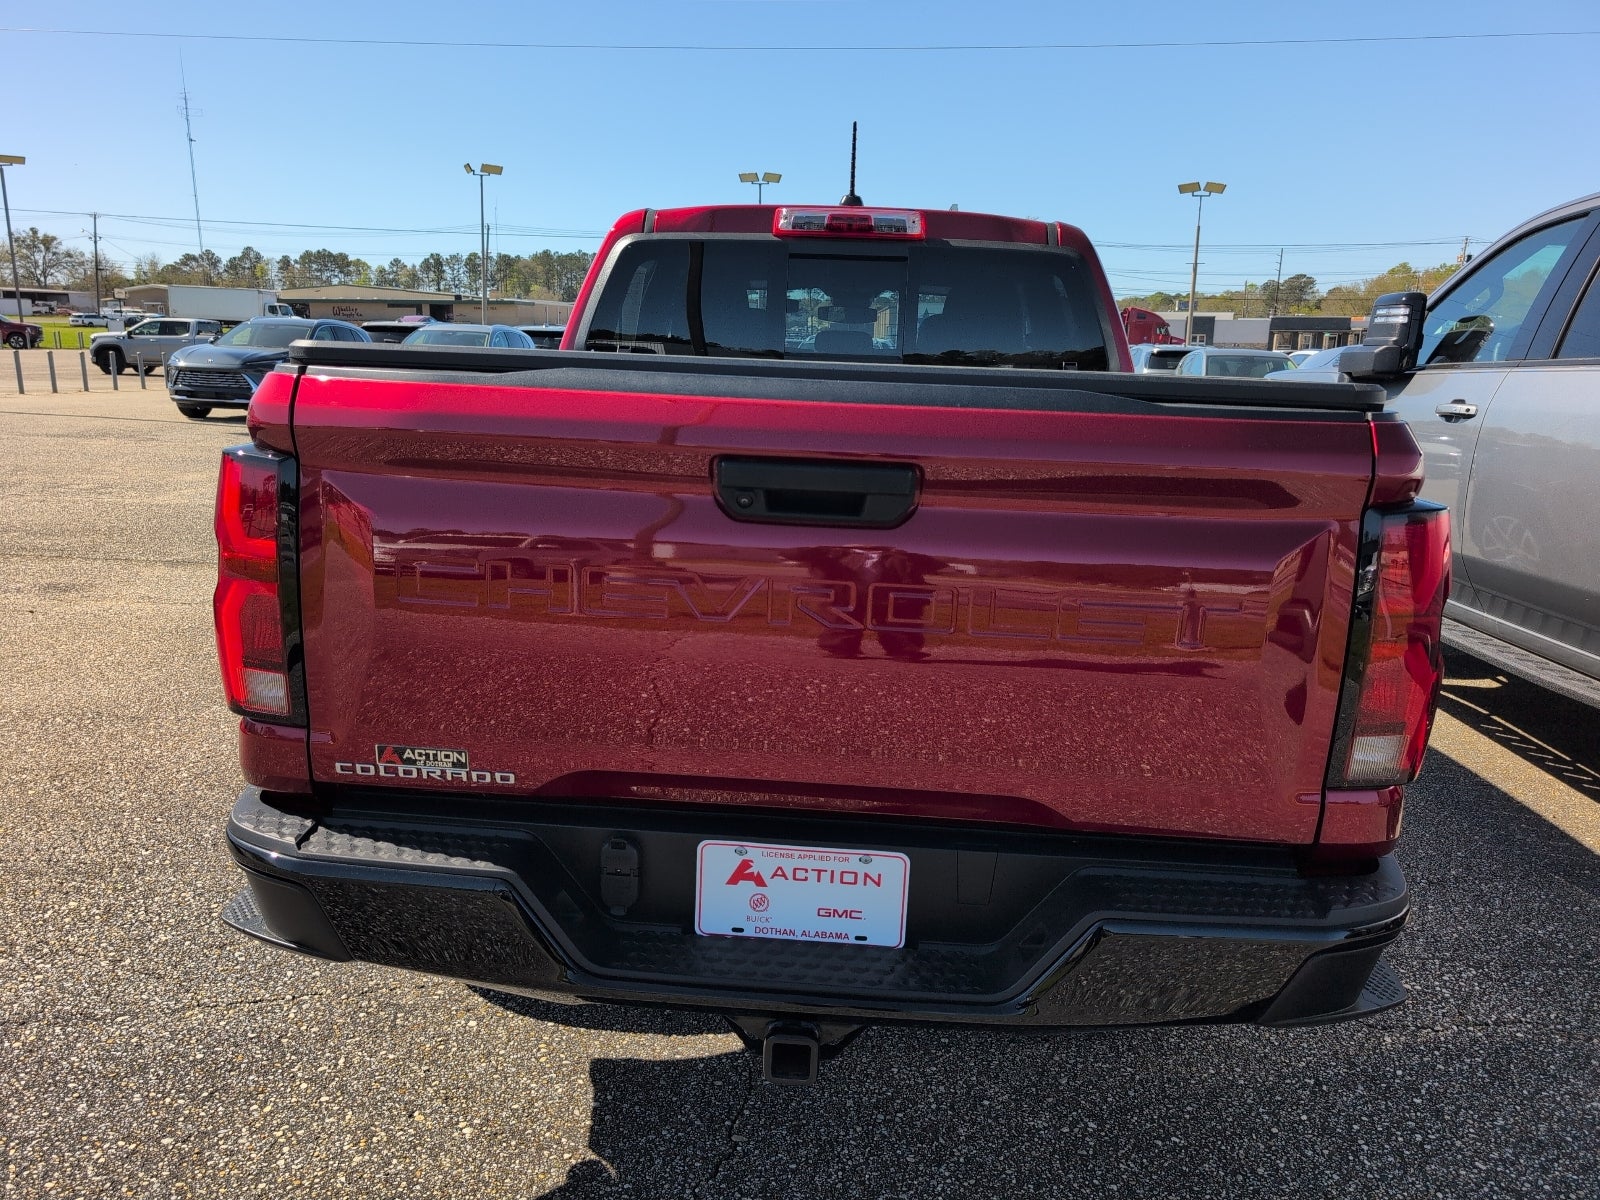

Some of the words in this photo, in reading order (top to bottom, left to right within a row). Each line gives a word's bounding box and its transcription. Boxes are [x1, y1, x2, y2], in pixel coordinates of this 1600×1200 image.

[396, 555, 1244, 650] CHEVROLET
[402, 748, 466, 763] ACTION
[425, 760, 453, 768] DOTHAN
[335, 762, 516, 784] COLORADO
[761, 850, 795, 859] LICENSE
[797, 853, 831, 862] APPLIED
[833, 855, 850, 863] FOR
[769, 866, 882, 888] ACTION
[746, 915, 770, 923] BUICK
[754, 926, 798, 938] DOTHAN,
[800, 929, 850, 941] ALABAMA
